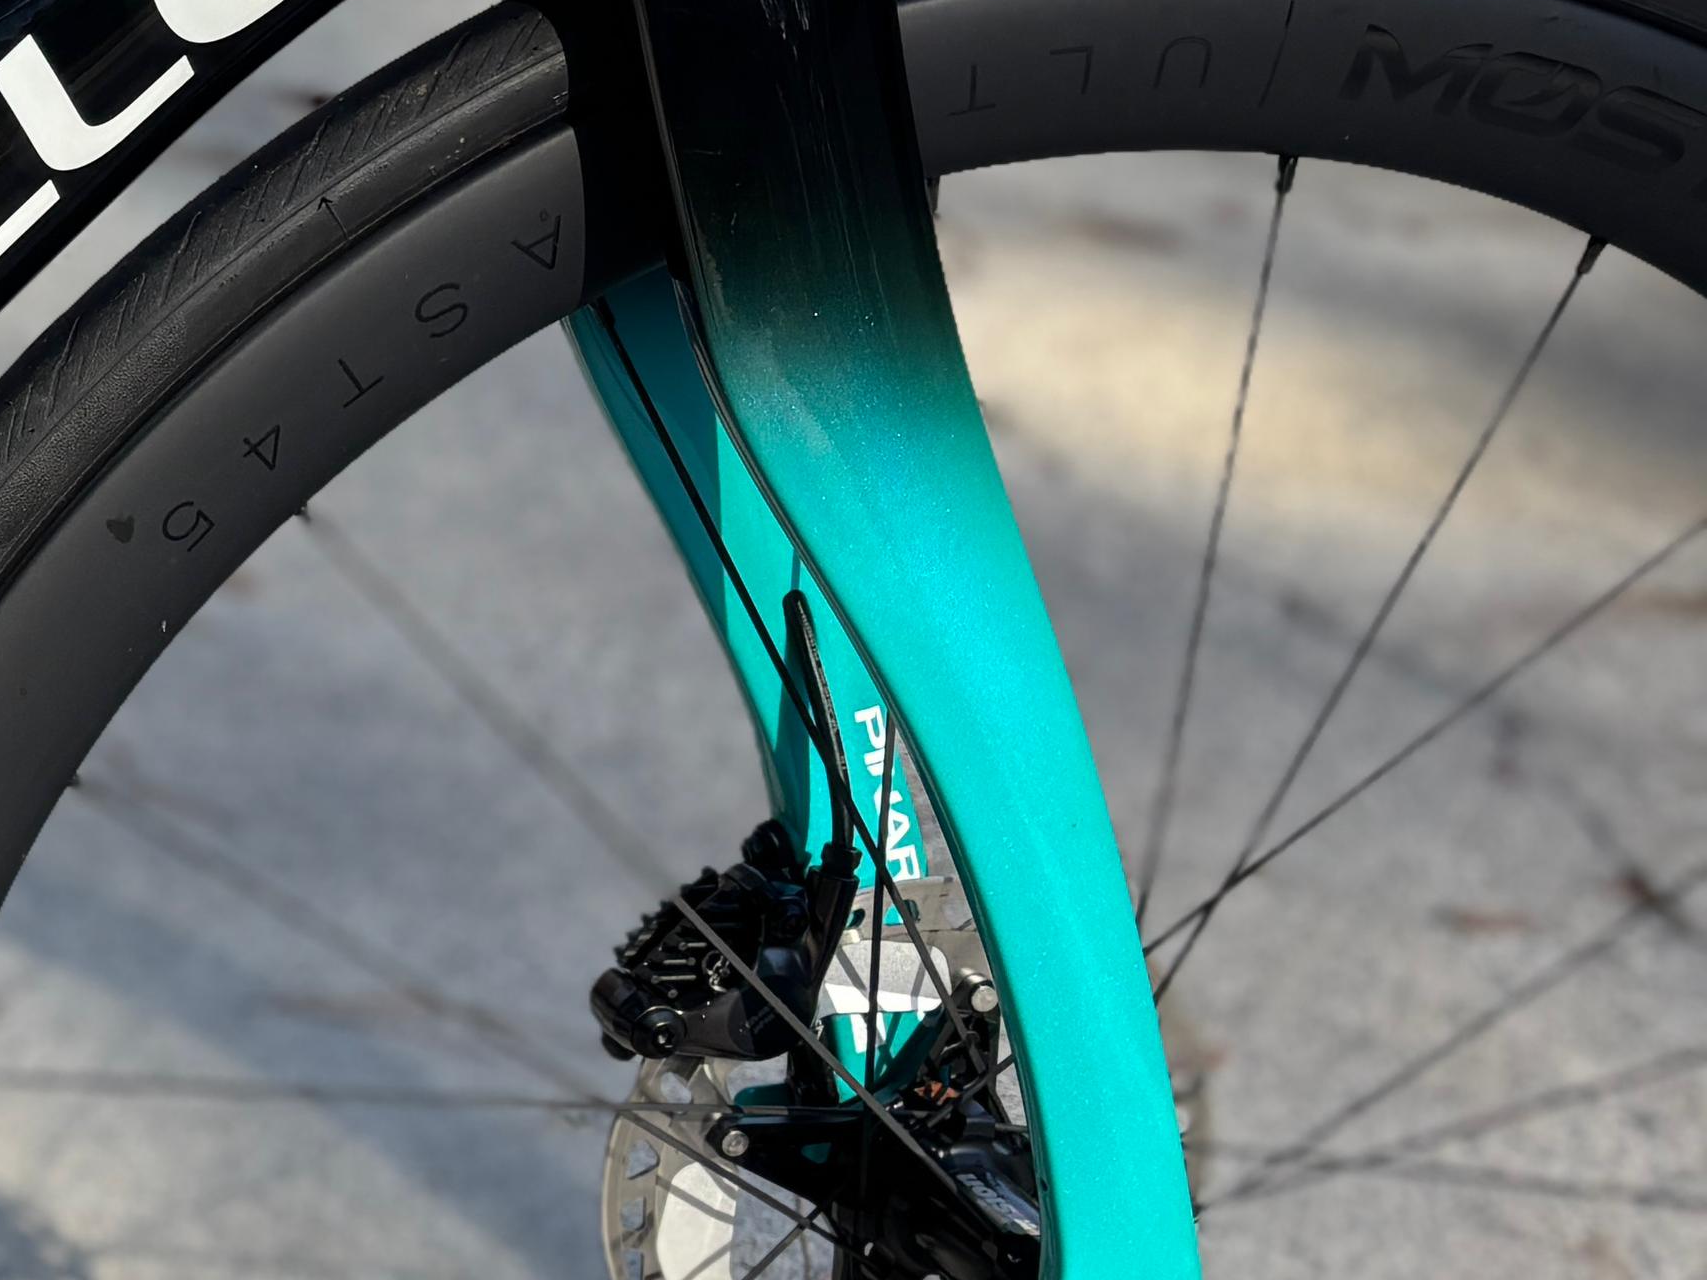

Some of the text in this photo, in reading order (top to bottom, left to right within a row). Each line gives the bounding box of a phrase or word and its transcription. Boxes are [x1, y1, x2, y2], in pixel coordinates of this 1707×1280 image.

[947, 34, 1212, 116] ULT
[1337, 22, 1697, 172] MOS
[335, 213, 563, 410] AST
